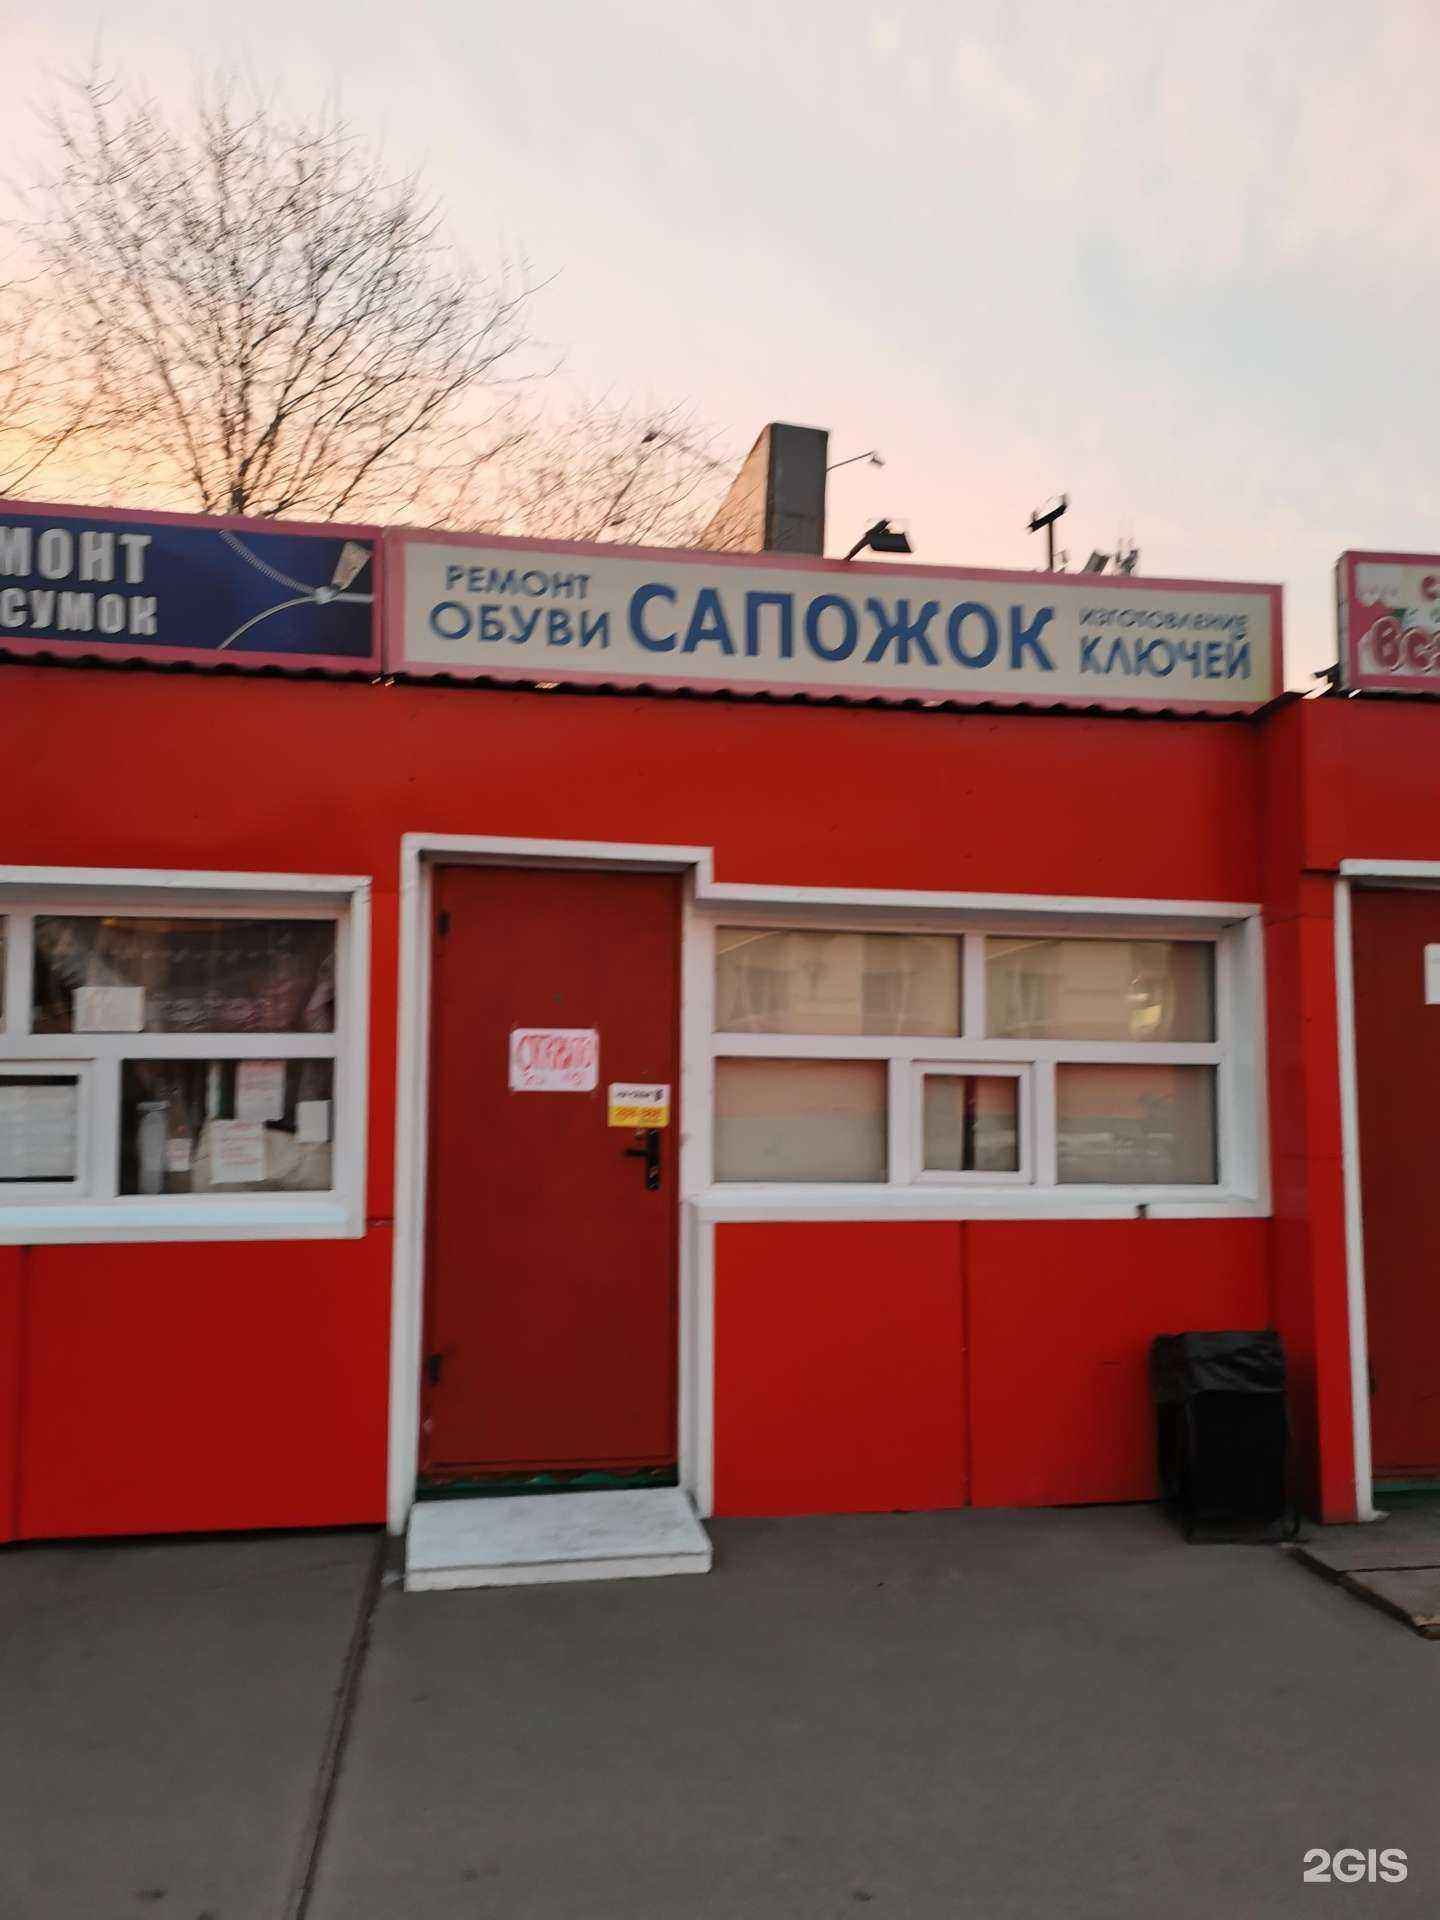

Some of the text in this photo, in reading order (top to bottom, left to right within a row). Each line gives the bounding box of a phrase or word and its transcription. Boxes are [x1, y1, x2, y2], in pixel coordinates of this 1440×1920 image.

[445, 564, 592, 600] РЕМОНТ
[0, 587, 157, 636] СУМОК
[430, 600, 611, 649] ОБУВИ
[629, 582, 1057, 672] САПОЖОК
[1079, 607, 1247, 632] ИЗГОТОВЛЕНИЕ
[1079, 634, 1251, 680] КЛЮЧЕЙ
